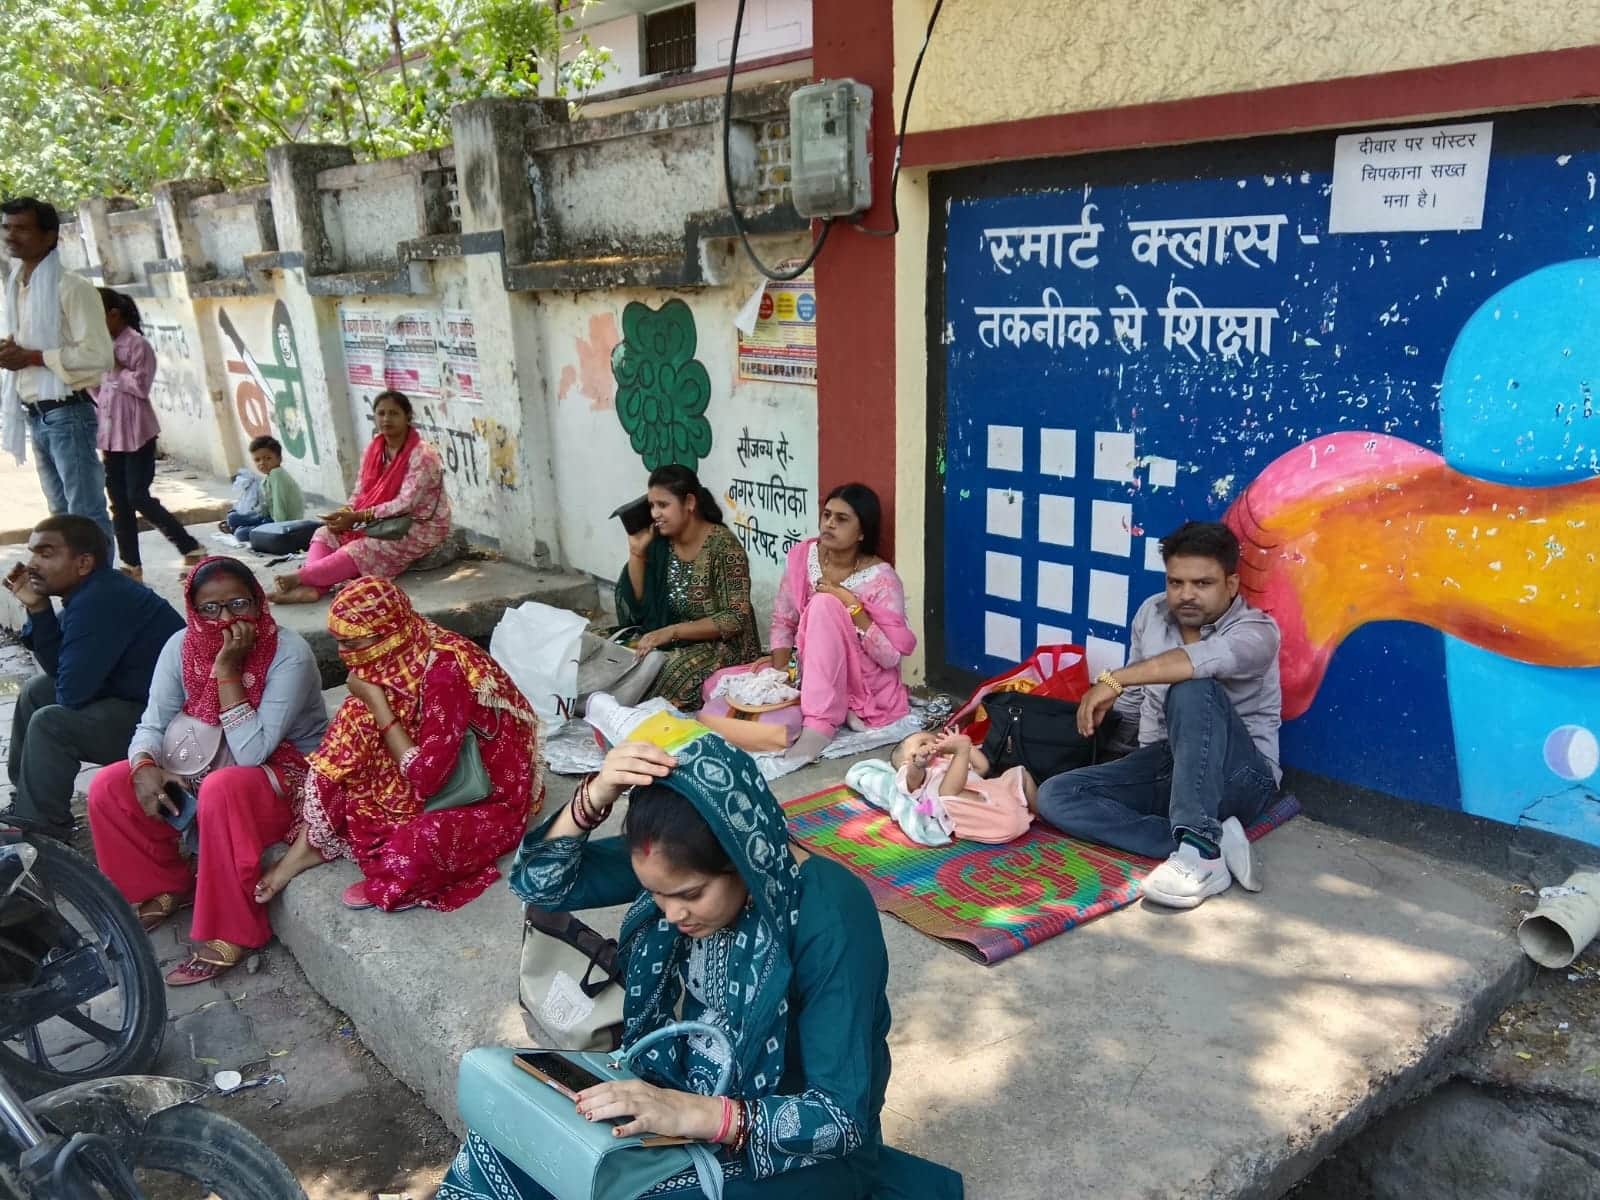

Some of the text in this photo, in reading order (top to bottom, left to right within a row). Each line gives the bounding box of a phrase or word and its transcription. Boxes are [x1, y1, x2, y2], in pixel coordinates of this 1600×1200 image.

[1358, 131, 1477, 155] दीवार पर पोस्टर
[1361, 162, 1468, 182] चिपकाना सख्त
[1382, 193, 1410, 209] मना
[983, 203, 1105, 275] स्मार्ट
[974, 284, 1280, 368] तकनीक से शिक्षा
[736, 424, 774, 468] सौजन्य
[728, 473, 808, 519] नगर पालिका
[733, 515, 779, 566] परिषद
